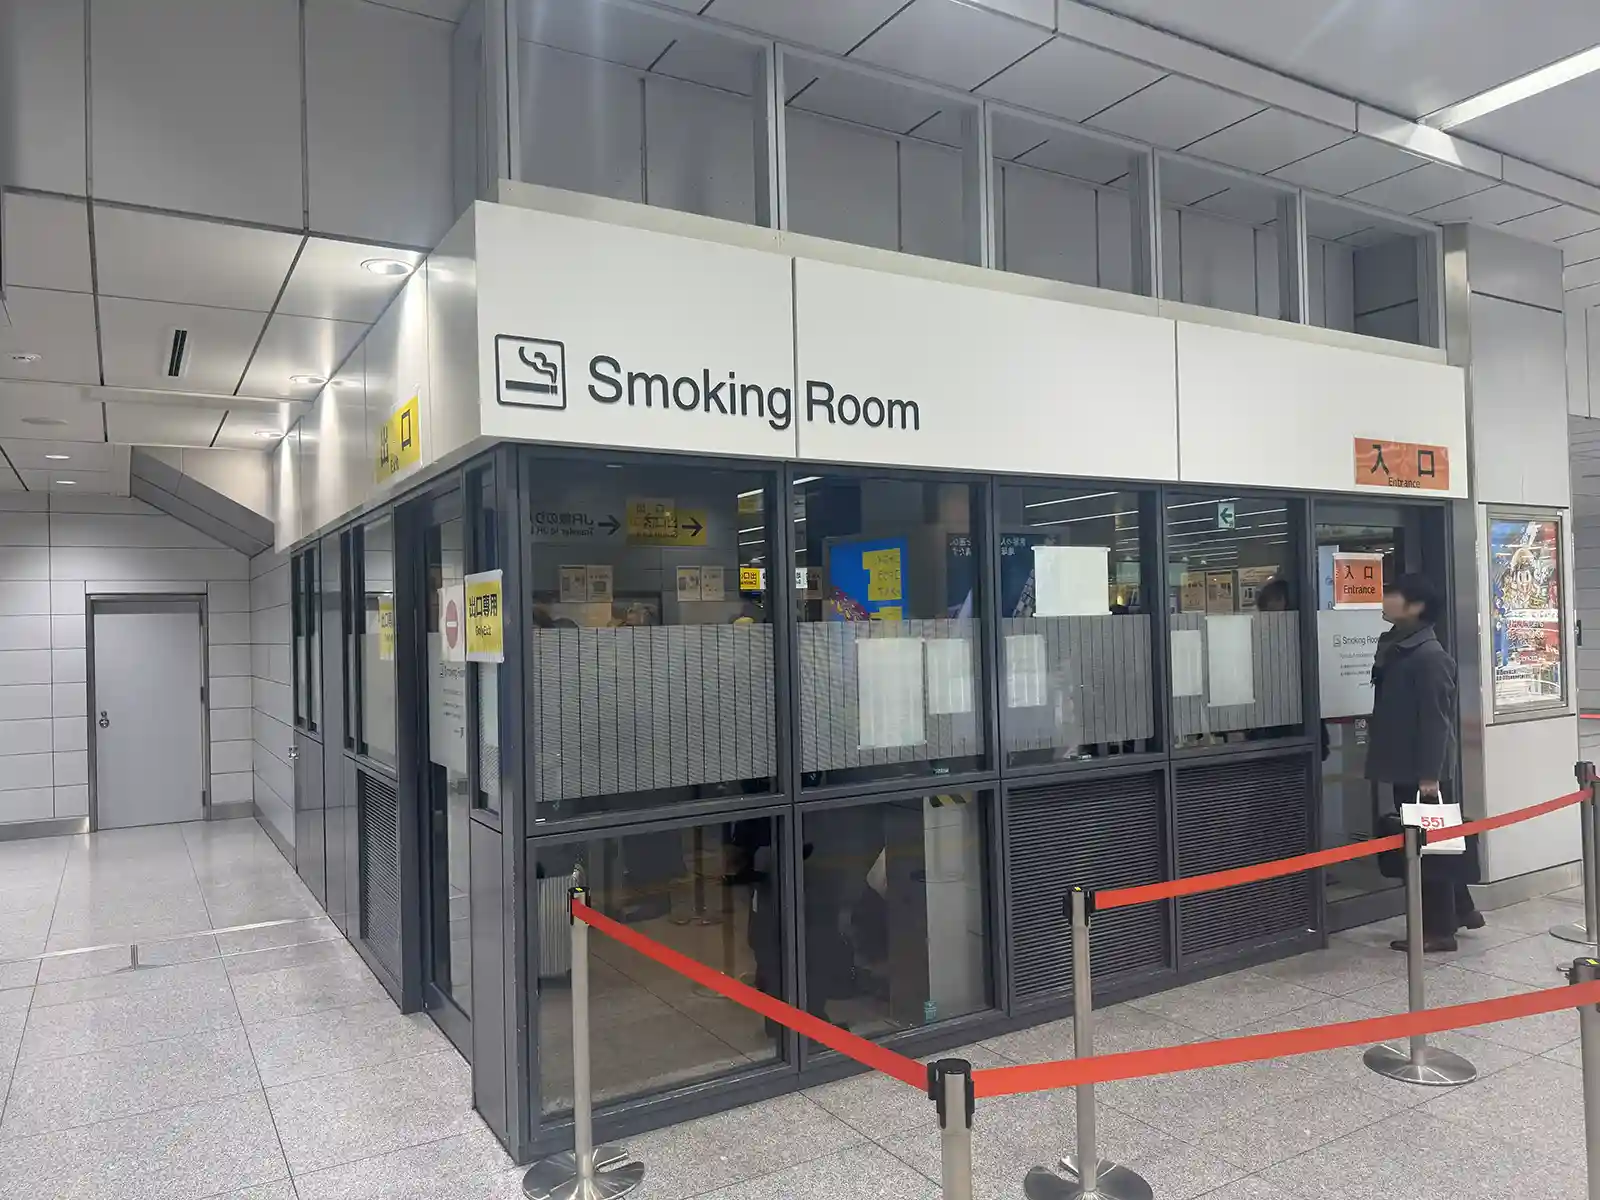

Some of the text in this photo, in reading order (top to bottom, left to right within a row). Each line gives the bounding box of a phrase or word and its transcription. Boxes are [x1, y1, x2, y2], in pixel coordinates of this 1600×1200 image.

[588, 355, 919, 430] Smoking Room
[380, 408, 411, 467] 出口
[1371, 444, 1434, 477] 入口
[1388, 477, 1421, 488] Entrance
[1344, 565, 1374, 579] 入口
[1343, 585, 1376, 595] Entrance
[469, 594, 498, 618] 出口専用
[1342, 636, 1379, 646] Smoking Roo
[1420, 816, 1445, 827] 551
